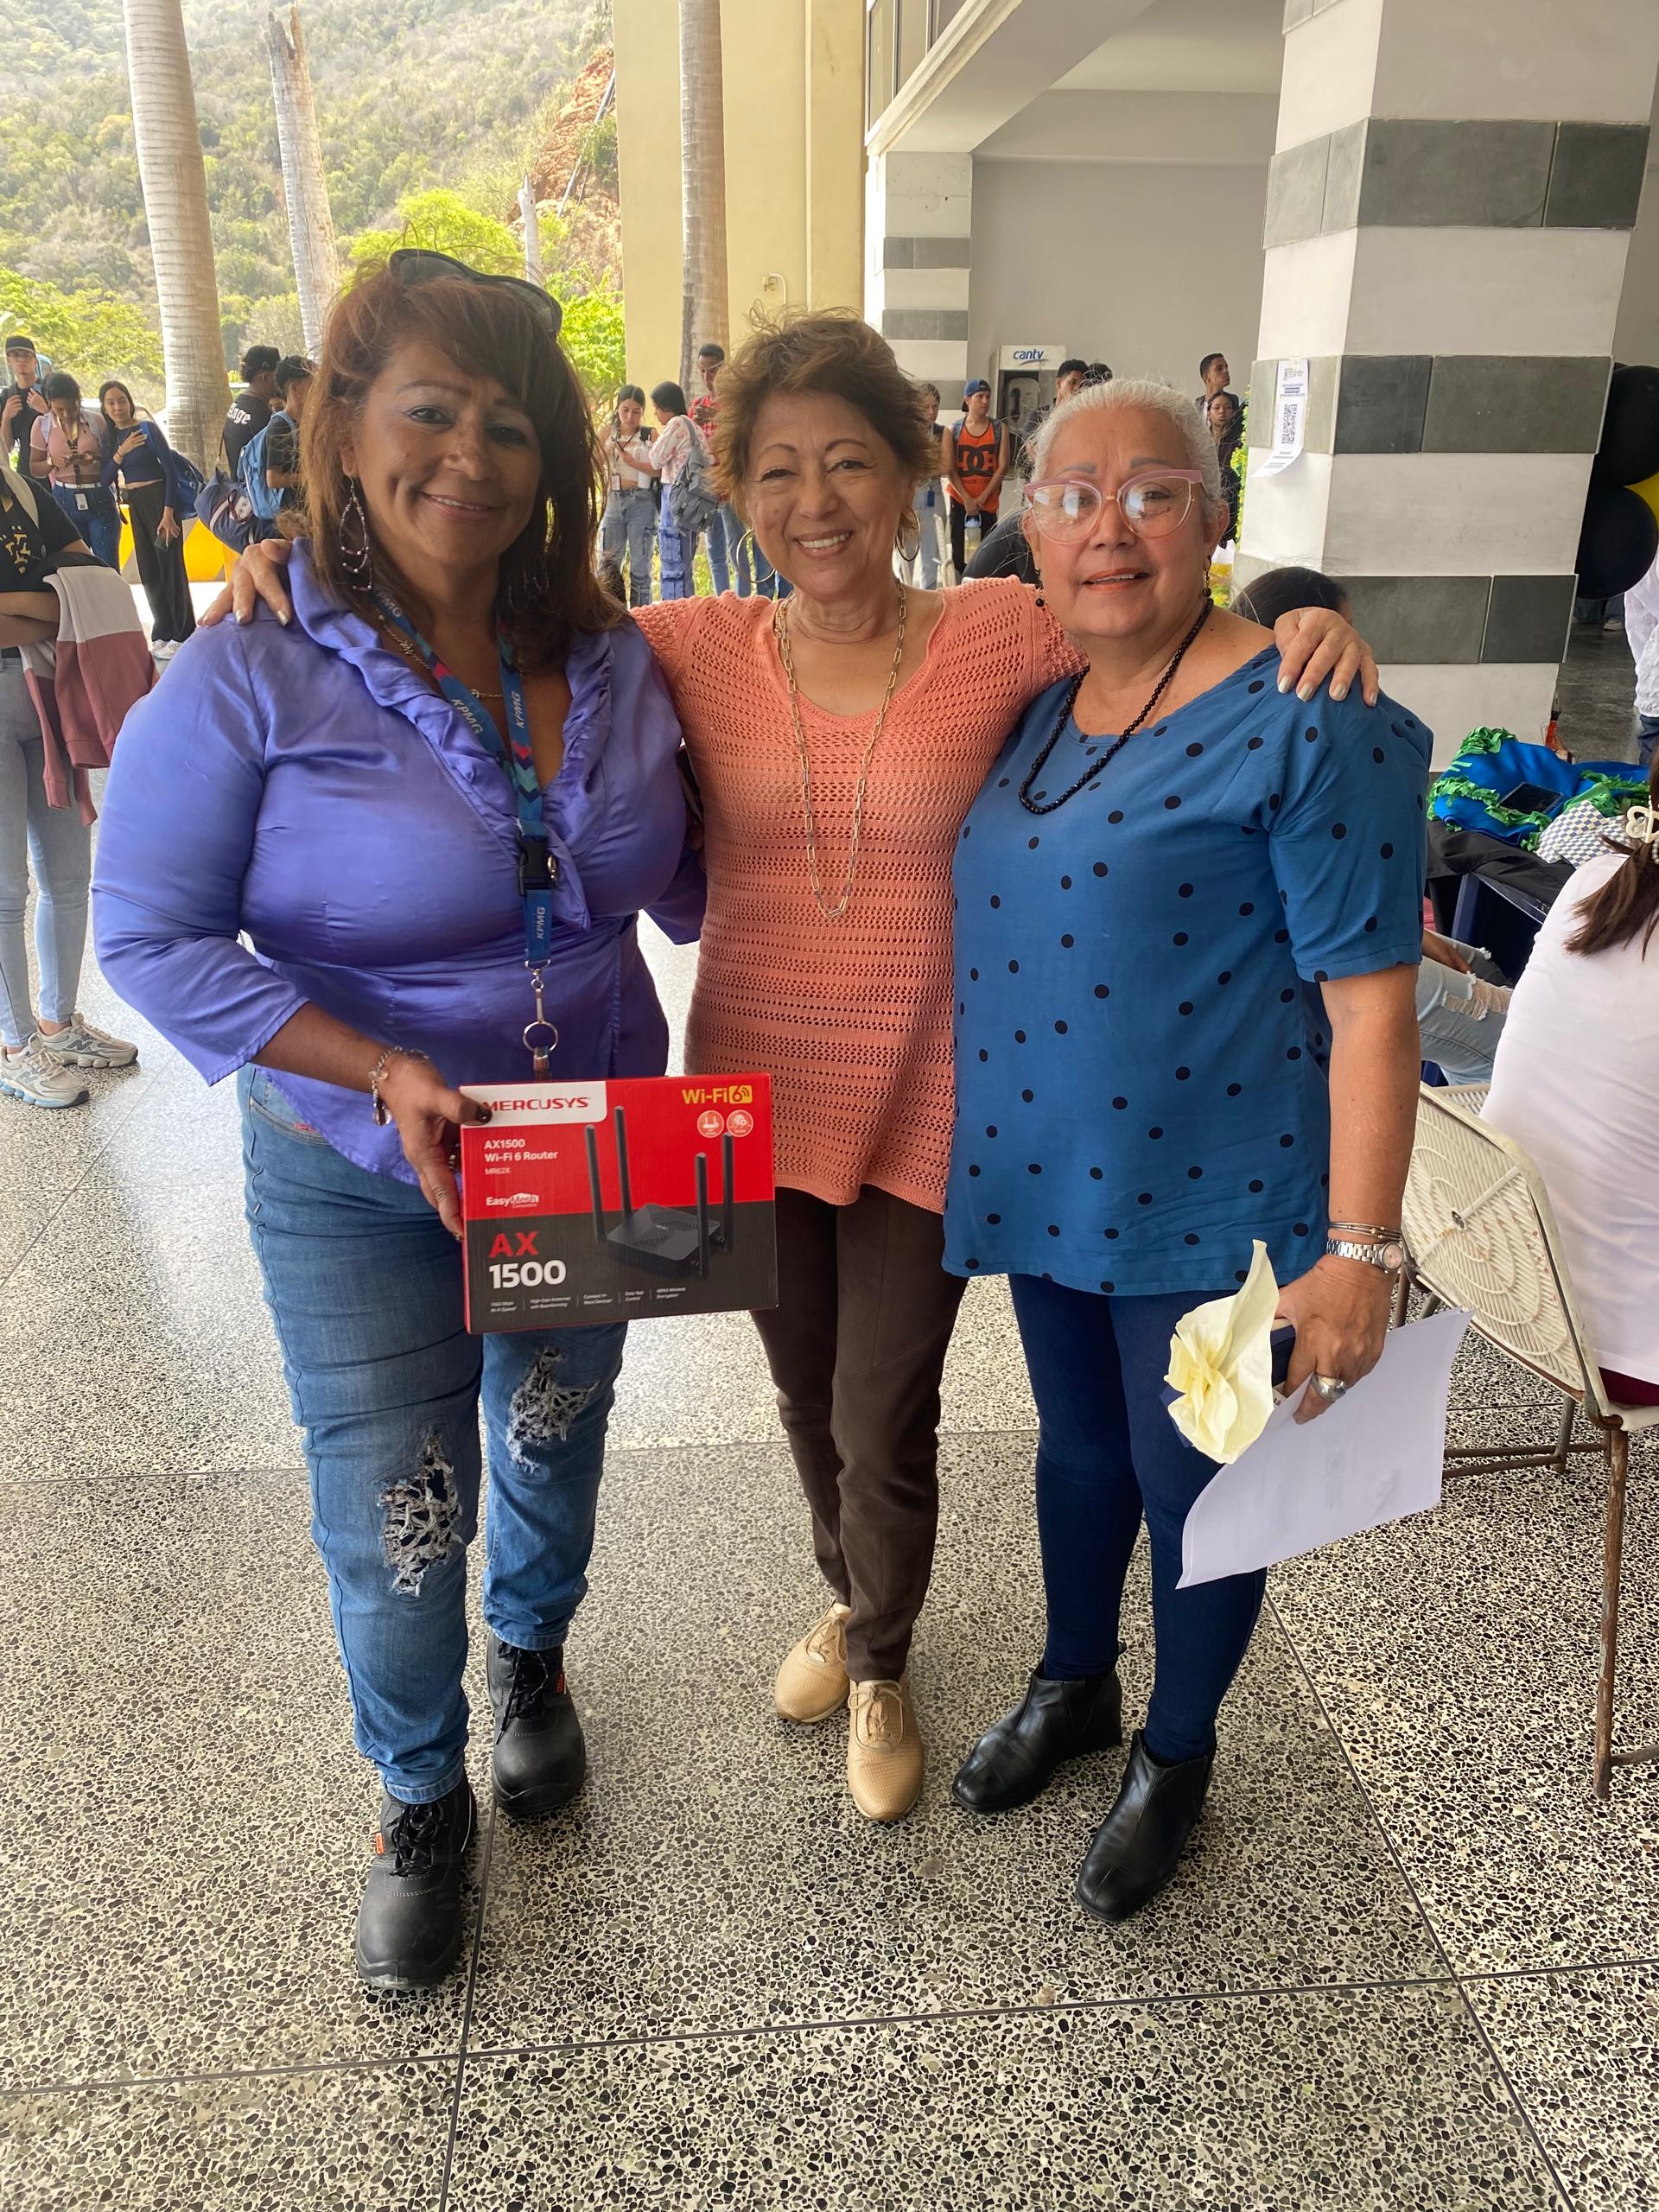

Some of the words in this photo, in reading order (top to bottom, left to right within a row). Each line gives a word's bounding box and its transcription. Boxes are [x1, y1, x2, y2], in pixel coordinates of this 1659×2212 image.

[1014, 349, 1044, 359] cantv
[451, 698, 484, 734] KPMG
[512, 691, 525, 729] KPMG
[536, 906, 546, 940] KPMG
[483, 1097, 589, 1111] MERCUSYS
[484, 1138, 525, 1150] AX1500
[484, 1152, 513, 1163] Wi-Fi
[514, 1151, 522, 1161] 6
[523, 1150, 559, 1160] Router
[489, 1230, 540, 1259] AX
[488, 1259, 567, 1289] 1500
